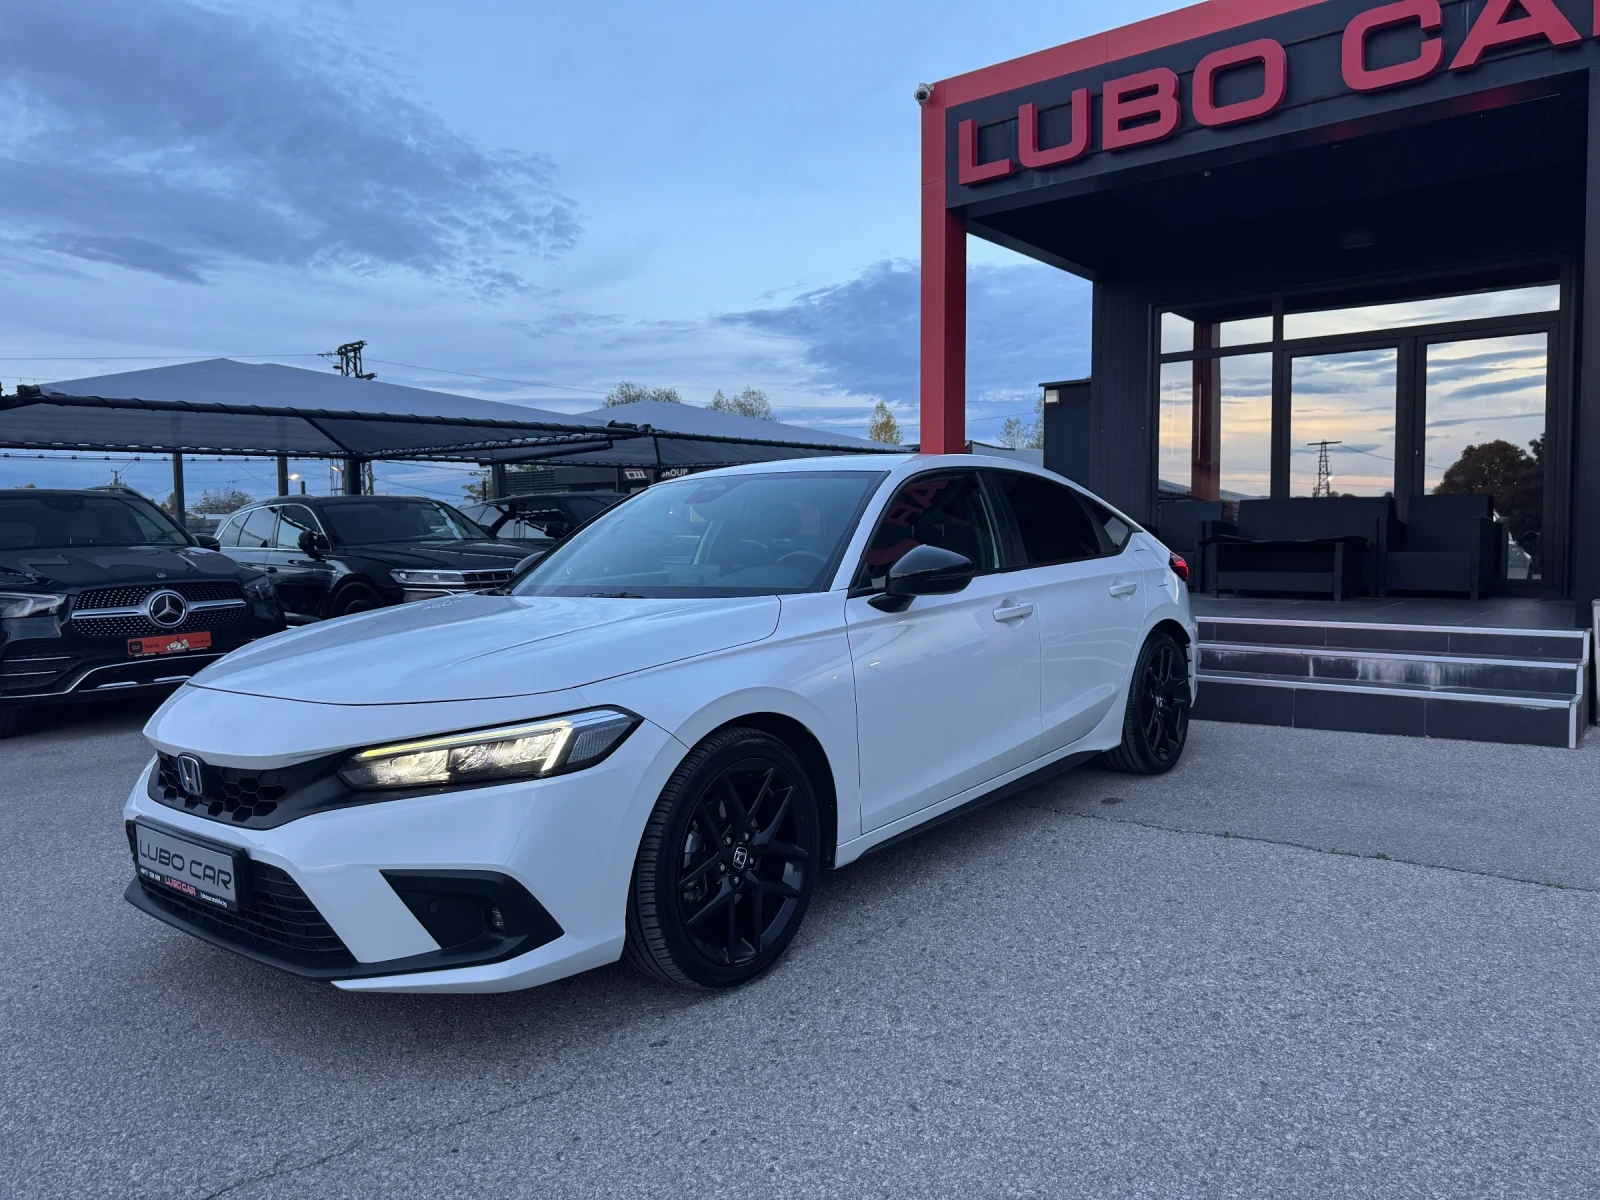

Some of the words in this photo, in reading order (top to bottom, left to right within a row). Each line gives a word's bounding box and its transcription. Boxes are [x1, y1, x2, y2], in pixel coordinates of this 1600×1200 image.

[958, 38, 1288, 186] LUBO
[1341, 0, 1600, 93] CA
[140, 839, 185, 872] LUBO
[189, 859, 232, 891] CAR
